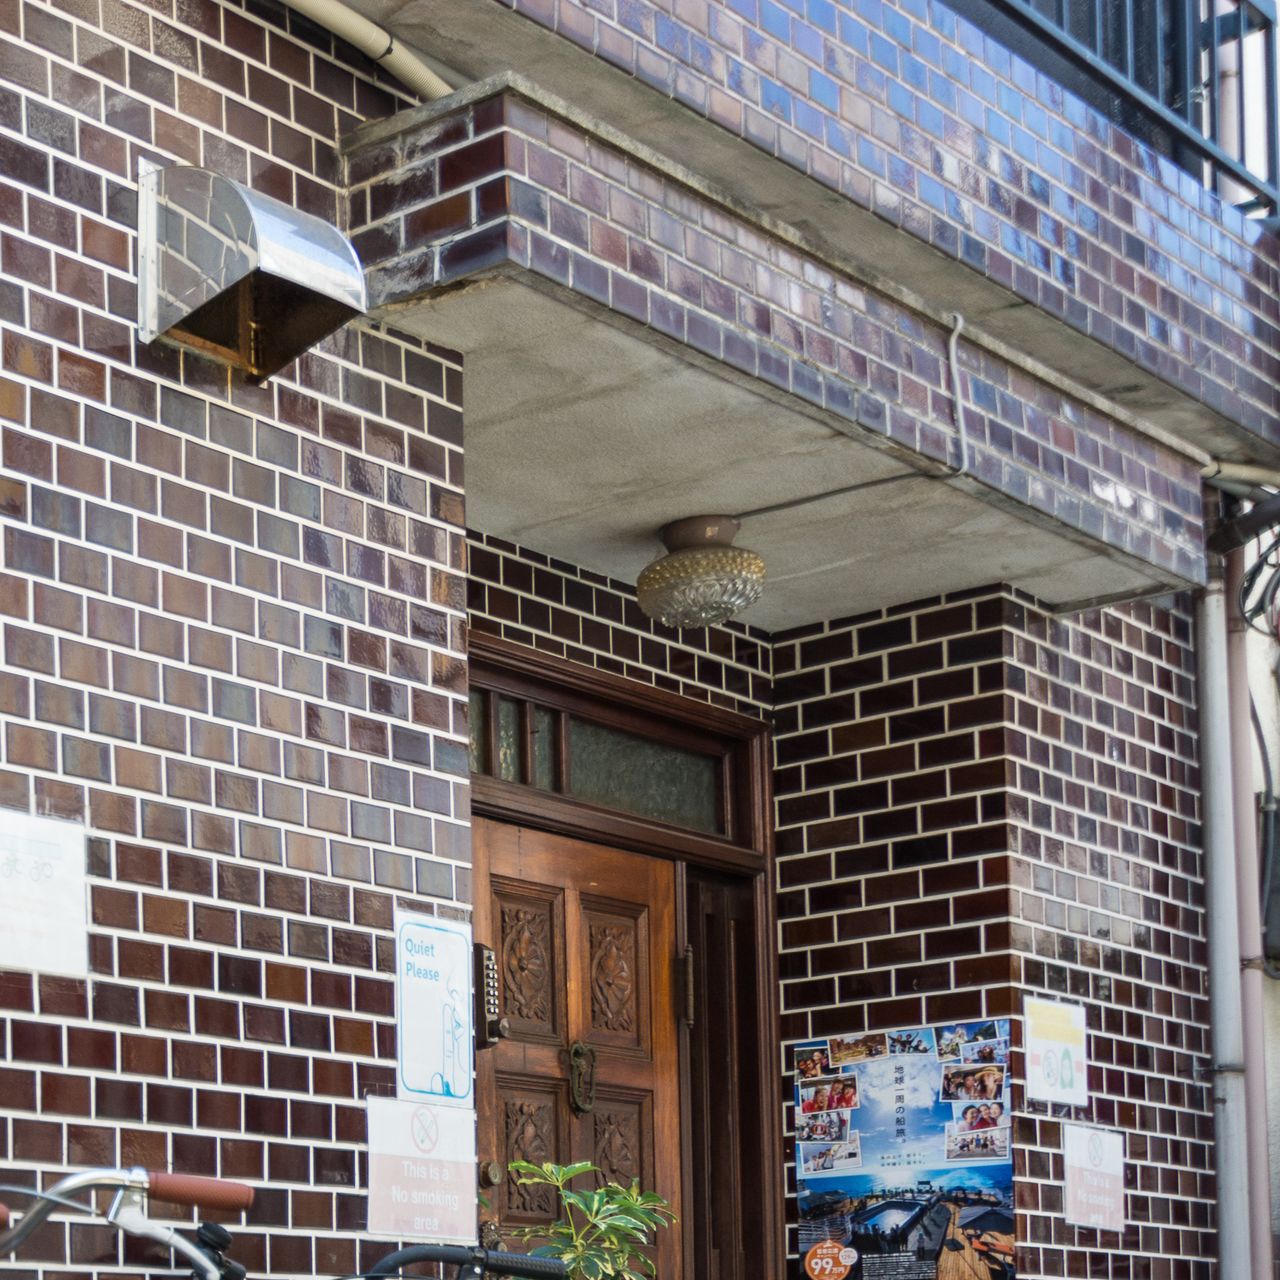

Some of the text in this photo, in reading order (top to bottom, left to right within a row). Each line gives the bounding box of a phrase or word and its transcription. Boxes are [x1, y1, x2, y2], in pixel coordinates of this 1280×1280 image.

[405, 938, 435, 957] Quiet
[406, 961, 439, 981] Please
[401, 1161, 427, 1179] This
[441, 1168, 449, 1181] a
[391, 1184, 459, 1211] No smoking
[414, 1215, 439, 1232] area
